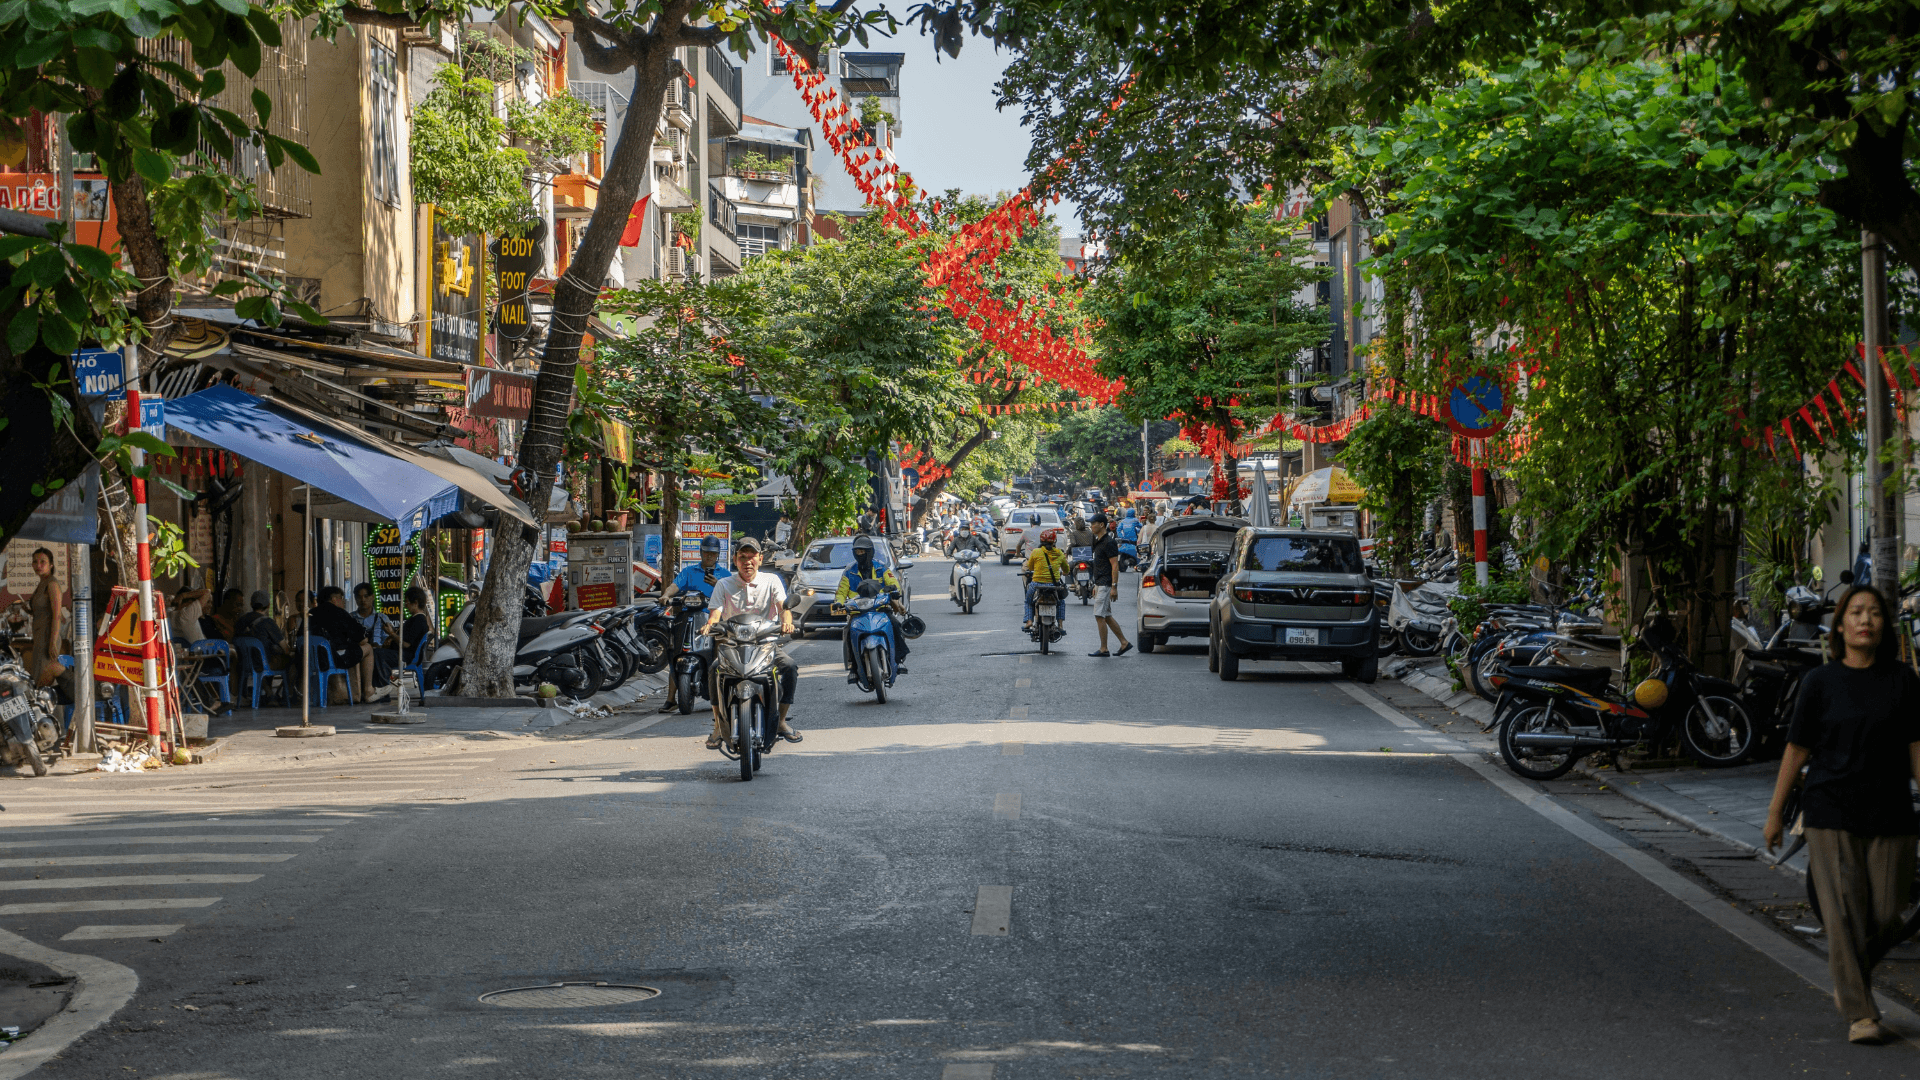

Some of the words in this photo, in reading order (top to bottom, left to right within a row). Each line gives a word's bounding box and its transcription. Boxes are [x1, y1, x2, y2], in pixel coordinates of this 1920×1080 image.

[501, 238, 534, 257] BODY
[501, 271, 526, 290] FOOT
[501, 304, 527, 325] NAIL
[85, 370, 120, 393] NÓN
[683, 524, 701, 532] MONEY
[701, 525, 727, 533] EXCHANGE
[377, 527, 400, 545] SP
[368, 546, 385, 555] FOOT
[373, 557, 388, 566] FOOT
[389, 556, 416, 566] HOSONE
[374, 569, 389, 578] FOOT
[389, 569, 410, 578] SCRB
[386, 581, 401, 590] COLO
[380, 606, 401, 615] FACIA
